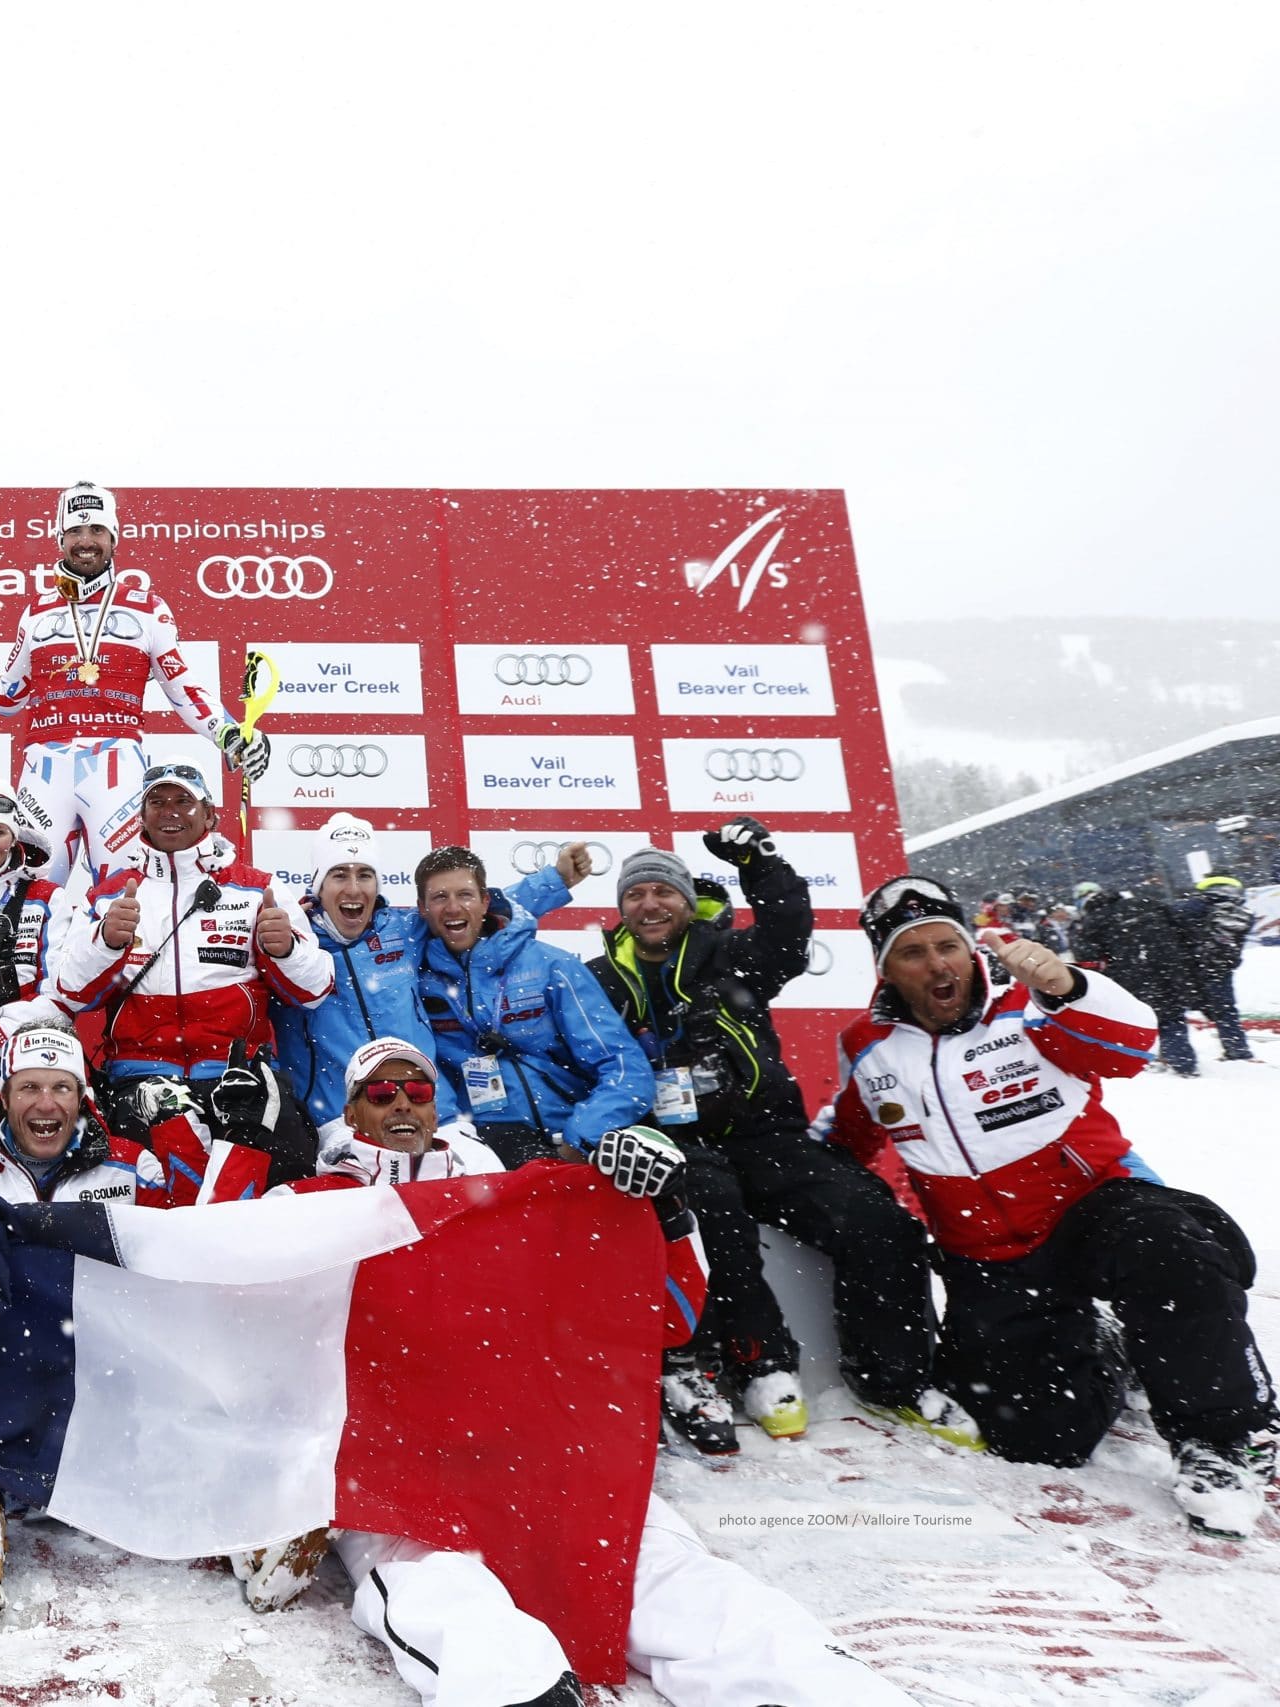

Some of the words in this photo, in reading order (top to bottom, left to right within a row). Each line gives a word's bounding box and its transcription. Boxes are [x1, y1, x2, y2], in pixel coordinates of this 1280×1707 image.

[26, 519, 61, 538] Sk
[122, 518, 327, 543] ampionships
[83, 581, 101, 597] uvex
[52, 656, 67, 664] FIS
[71, 655, 110, 664] ALNE
[318, 663, 352, 676] Vail
[724, 665, 760, 677] Vail
[344, 681, 401, 693] Creek
[678, 683, 747, 695] Beaver
[753, 683, 811, 695] Creek
[47, 688, 100, 700] BEAVER
[501, 695, 542, 706] Audi
[30, 712, 63, 730] Audi
[69, 712, 139, 725] quattro
[531, 757, 565, 770] Vail
[483, 775, 552, 788] Beaver
[558, 775, 616, 788] Creek
[294, 787, 336, 798] Audi
[713, 792, 755, 802] Audi
[20, 794, 53, 830] COLMAR
[276, 871, 312, 884] Bea
[381, 872, 412, 884] eek
[700, 873, 739, 886] Bea
[806, 874, 838, 886] eek
[216, 901, 249, 911] COLMAR
[32, 1037, 40, 1046] la
[976, 1034, 1022, 1056] COLMAR
[995, 1060, 1025, 1074] CAISSE
[93, 1185, 132, 1201] COLMAR
